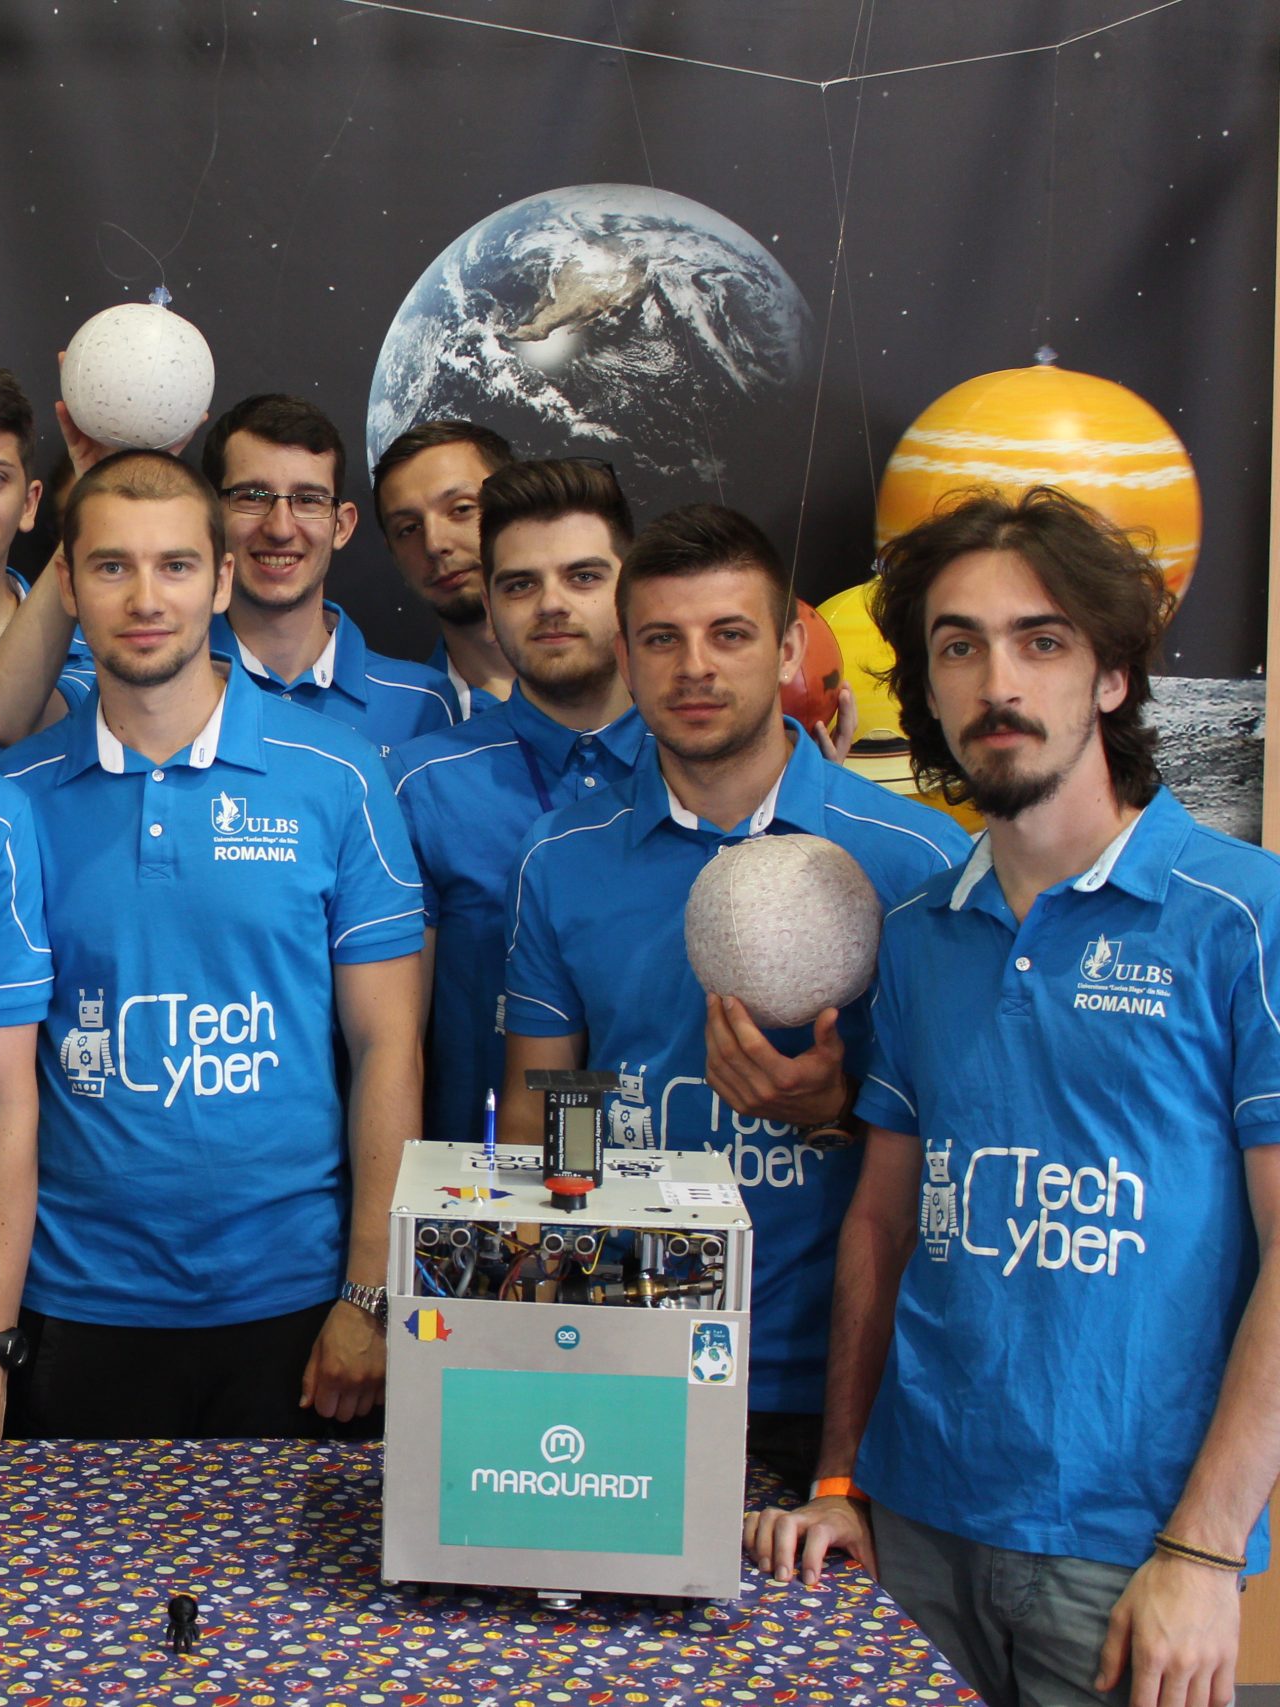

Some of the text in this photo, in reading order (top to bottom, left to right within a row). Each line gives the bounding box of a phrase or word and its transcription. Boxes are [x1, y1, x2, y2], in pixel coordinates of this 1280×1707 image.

[246, 817, 299, 834] ULBS
[214, 846, 297, 863] ROMANIA
[1115, 964, 1173, 985] ULBS
[1073, 993, 1166, 1018] ROMANIA
[472, 1468, 653, 1499] MARQUARDT
